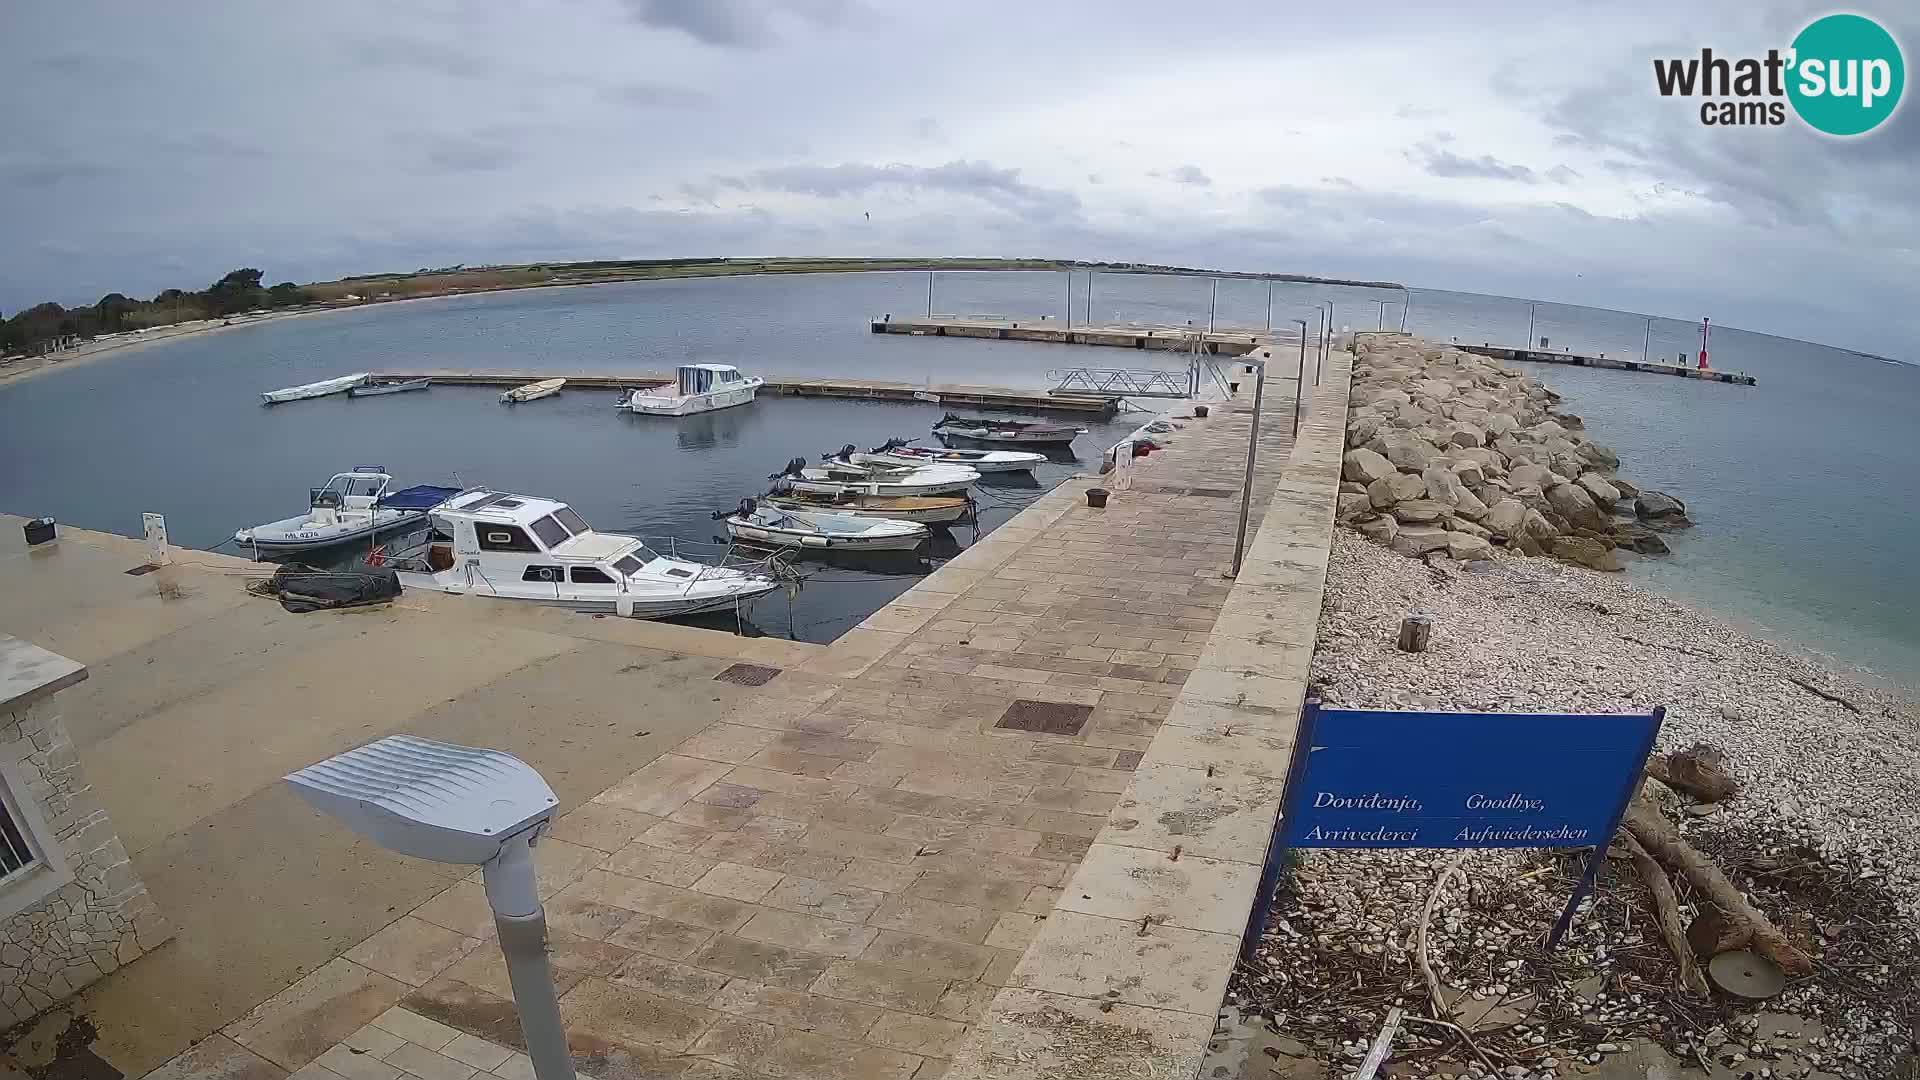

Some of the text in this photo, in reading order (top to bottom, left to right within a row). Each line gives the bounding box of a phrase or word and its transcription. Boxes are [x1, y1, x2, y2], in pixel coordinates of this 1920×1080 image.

[284, 531, 299, 539] ML
[1312, 791, 1545, 813] Doviđenja, Goodbye,
[1303, 824, 1588, 844] Arrivederci Aufwiedersehen
